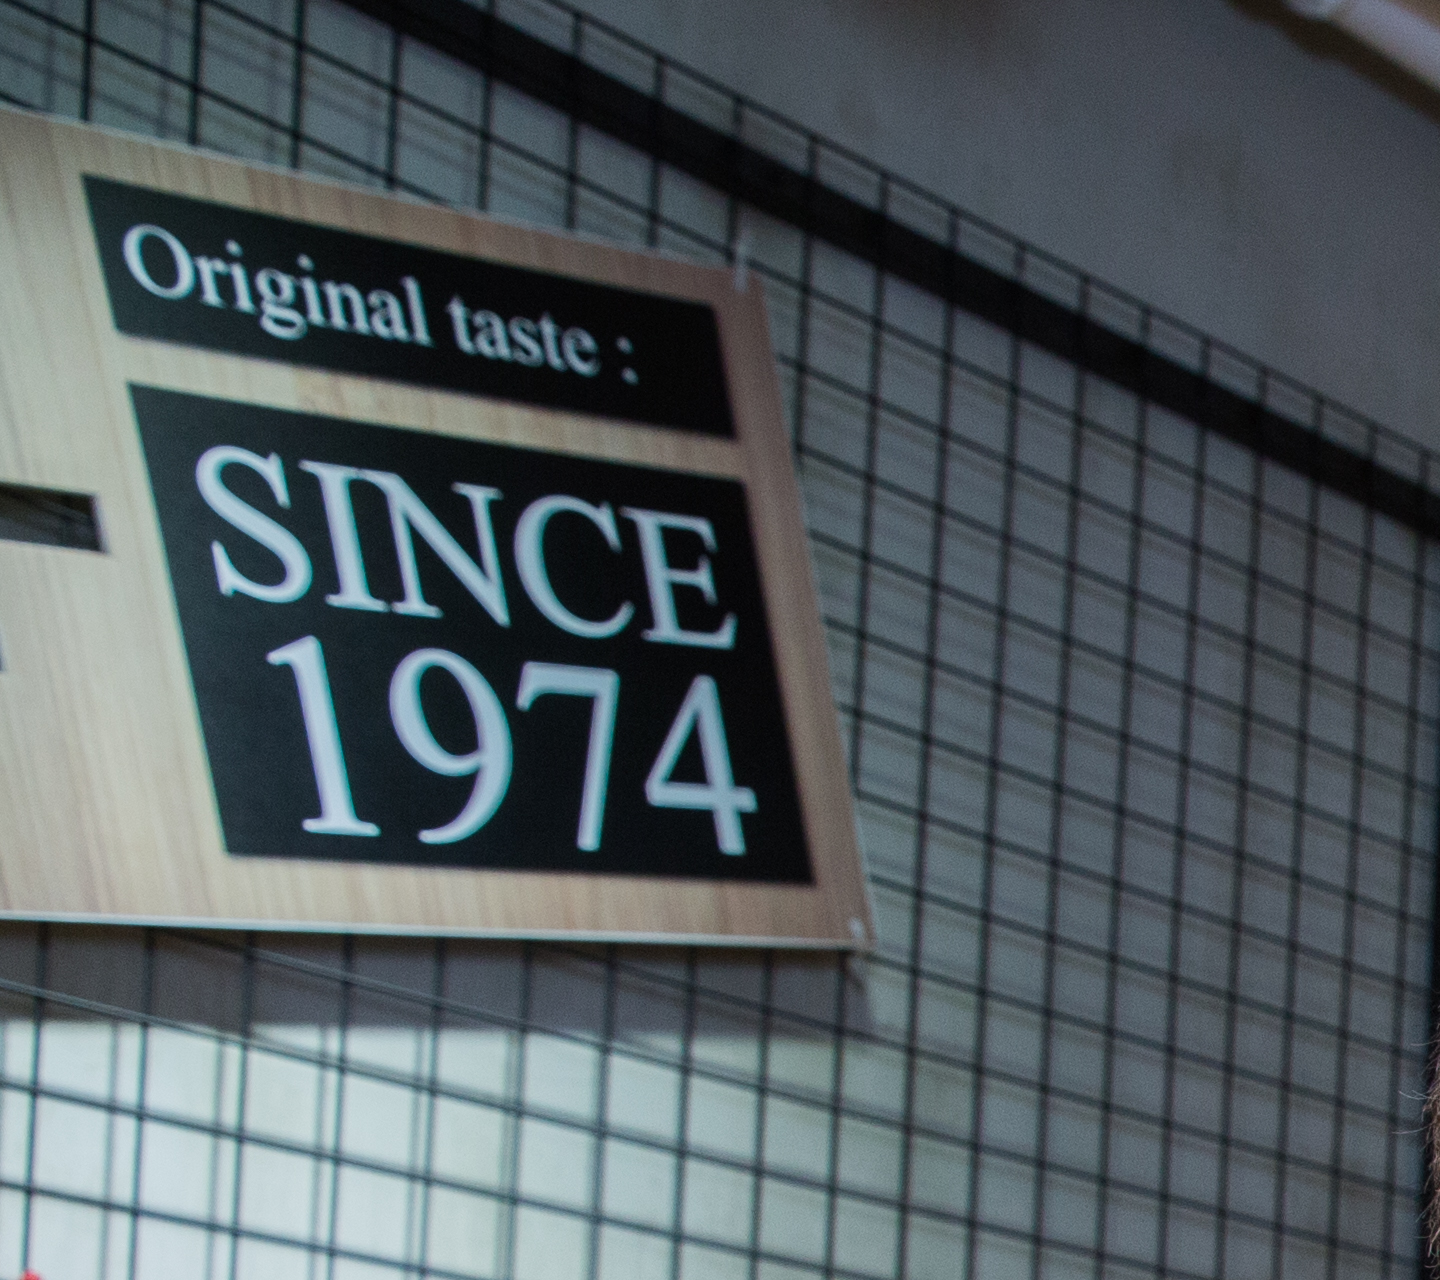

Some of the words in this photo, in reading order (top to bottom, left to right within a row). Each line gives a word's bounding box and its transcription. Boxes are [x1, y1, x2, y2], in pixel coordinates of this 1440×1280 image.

[121, 223, 433, 347] Original
[446, 293, 600, 376] taste
[195, 444, 739, 650] SINCE
[266, 634, 758, 857] 1974
